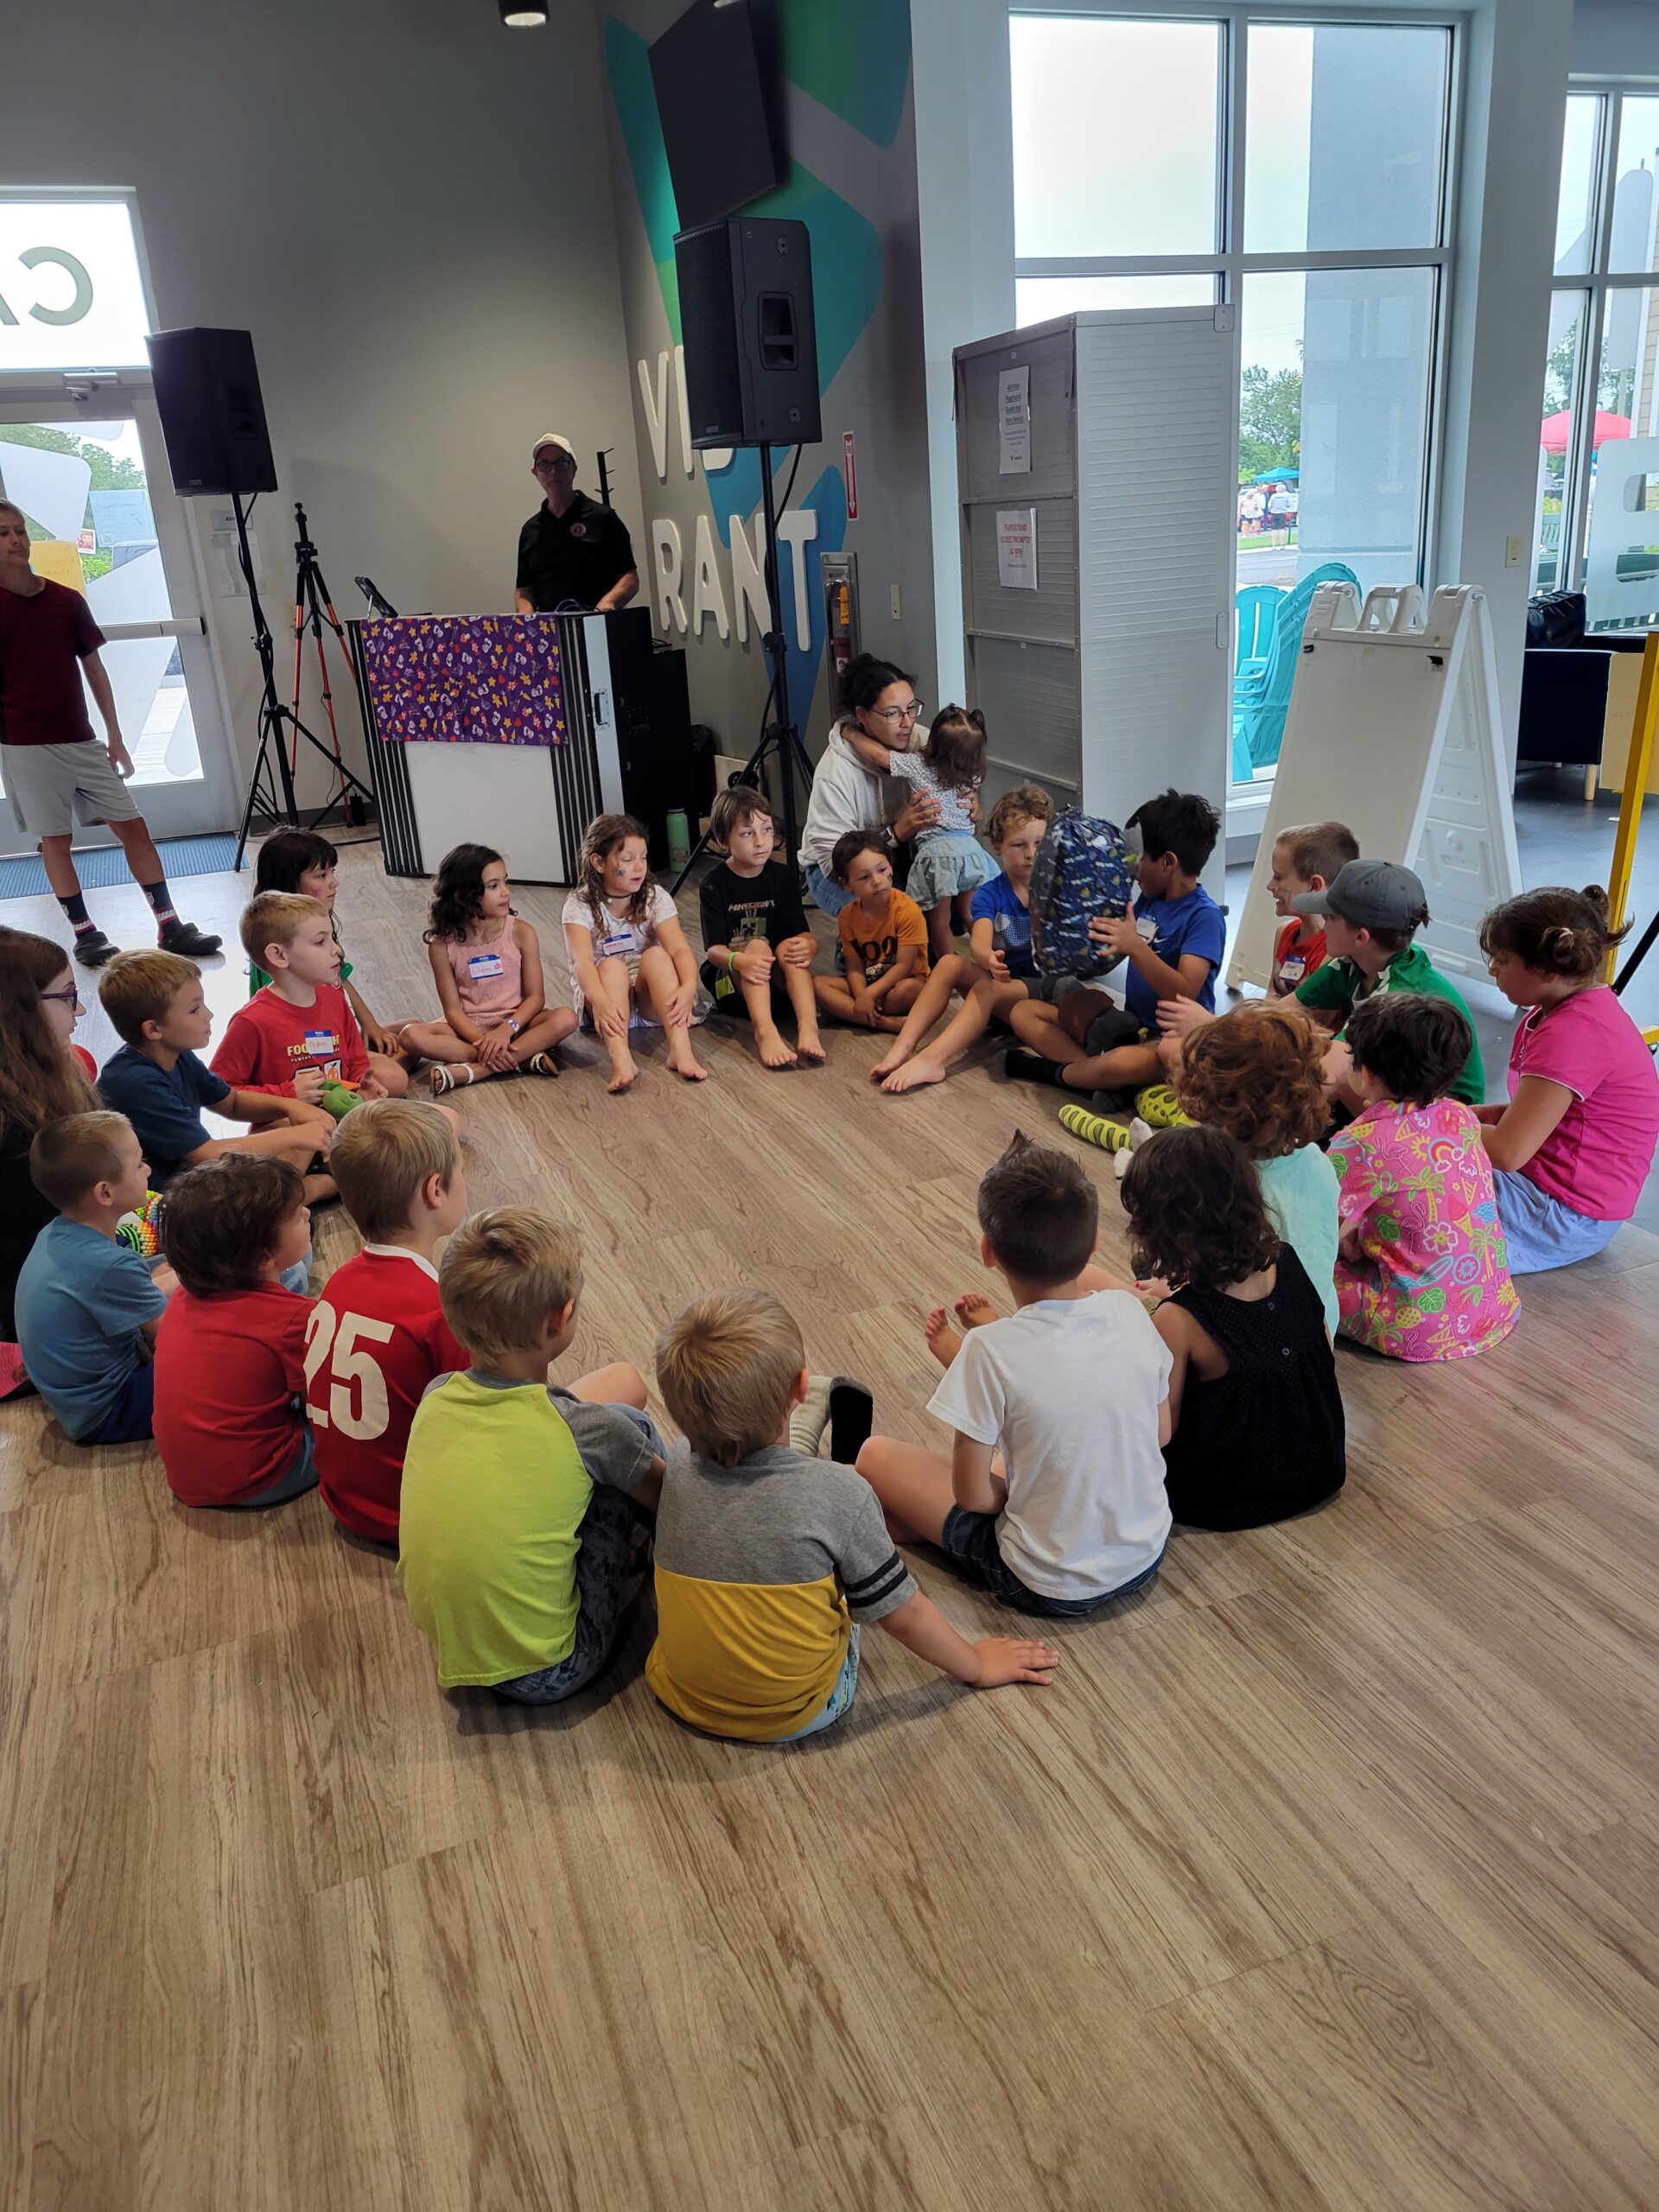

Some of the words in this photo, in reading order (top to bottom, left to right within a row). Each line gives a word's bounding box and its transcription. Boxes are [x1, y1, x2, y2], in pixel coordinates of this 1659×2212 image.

[652, 509, 817, 652] RANT
[728, 899, 775, 911] MINECRAFT
[303, 1300, 395, 1440] 25
